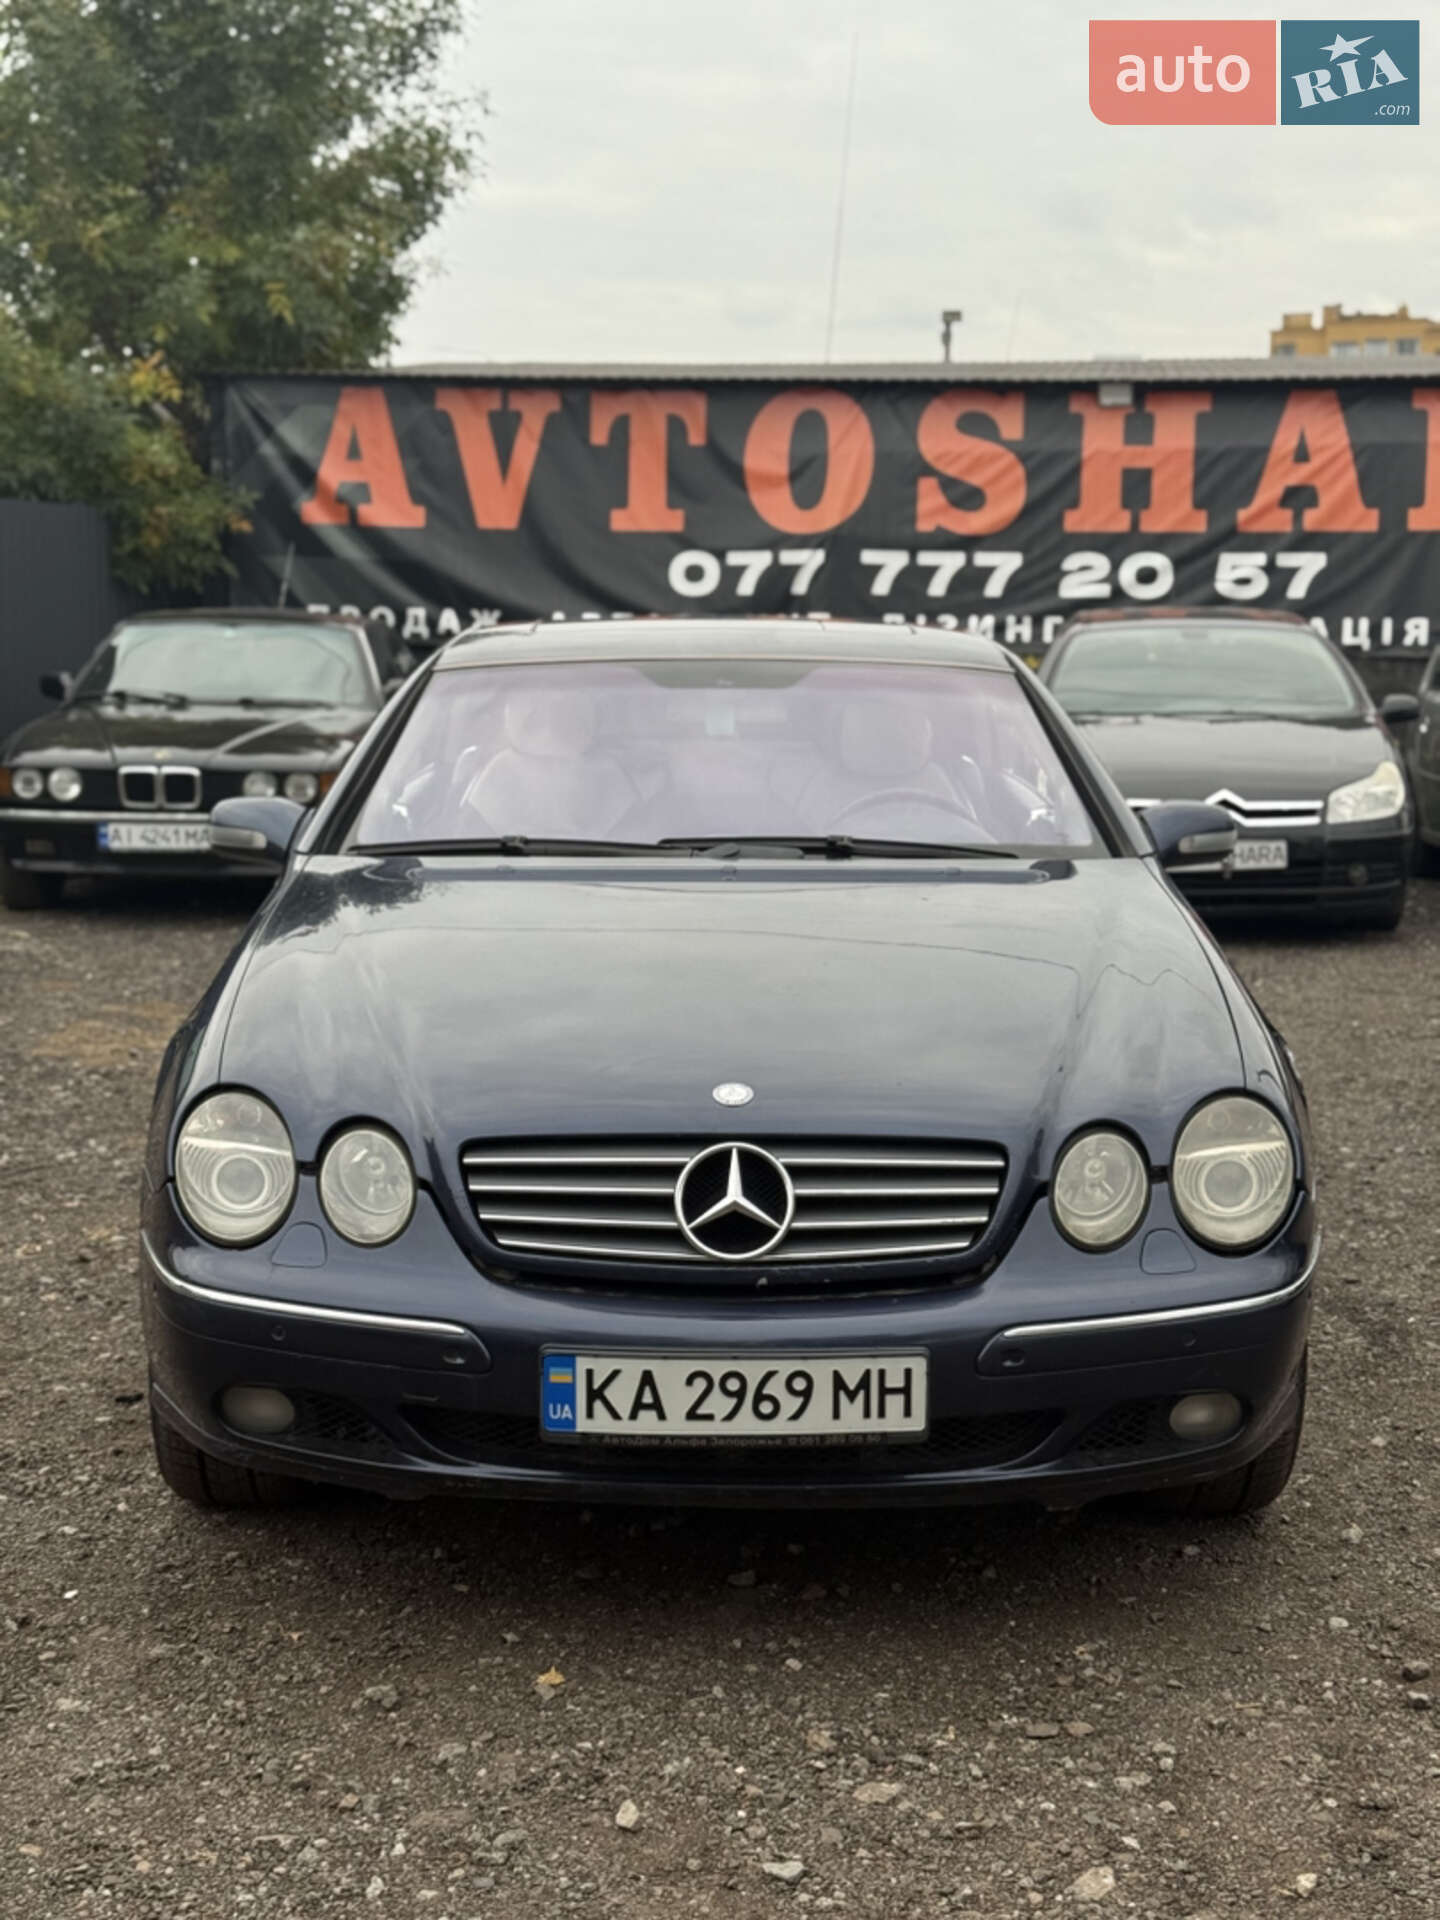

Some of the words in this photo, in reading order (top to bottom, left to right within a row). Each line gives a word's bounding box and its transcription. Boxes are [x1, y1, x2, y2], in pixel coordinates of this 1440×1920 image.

[668, 549, 826, 597] 077
[860, 549, 1023, 598] 777
[1058, 551, 1175, 600] 20
[1214, 551, 1328, 600] 57
[549, 1403, 574, 1420] UA
[585, 1367, 668, 1421] KA
[684, 1369, 815, 1422] 2969
[832, 1367, 913, 1421] MH
